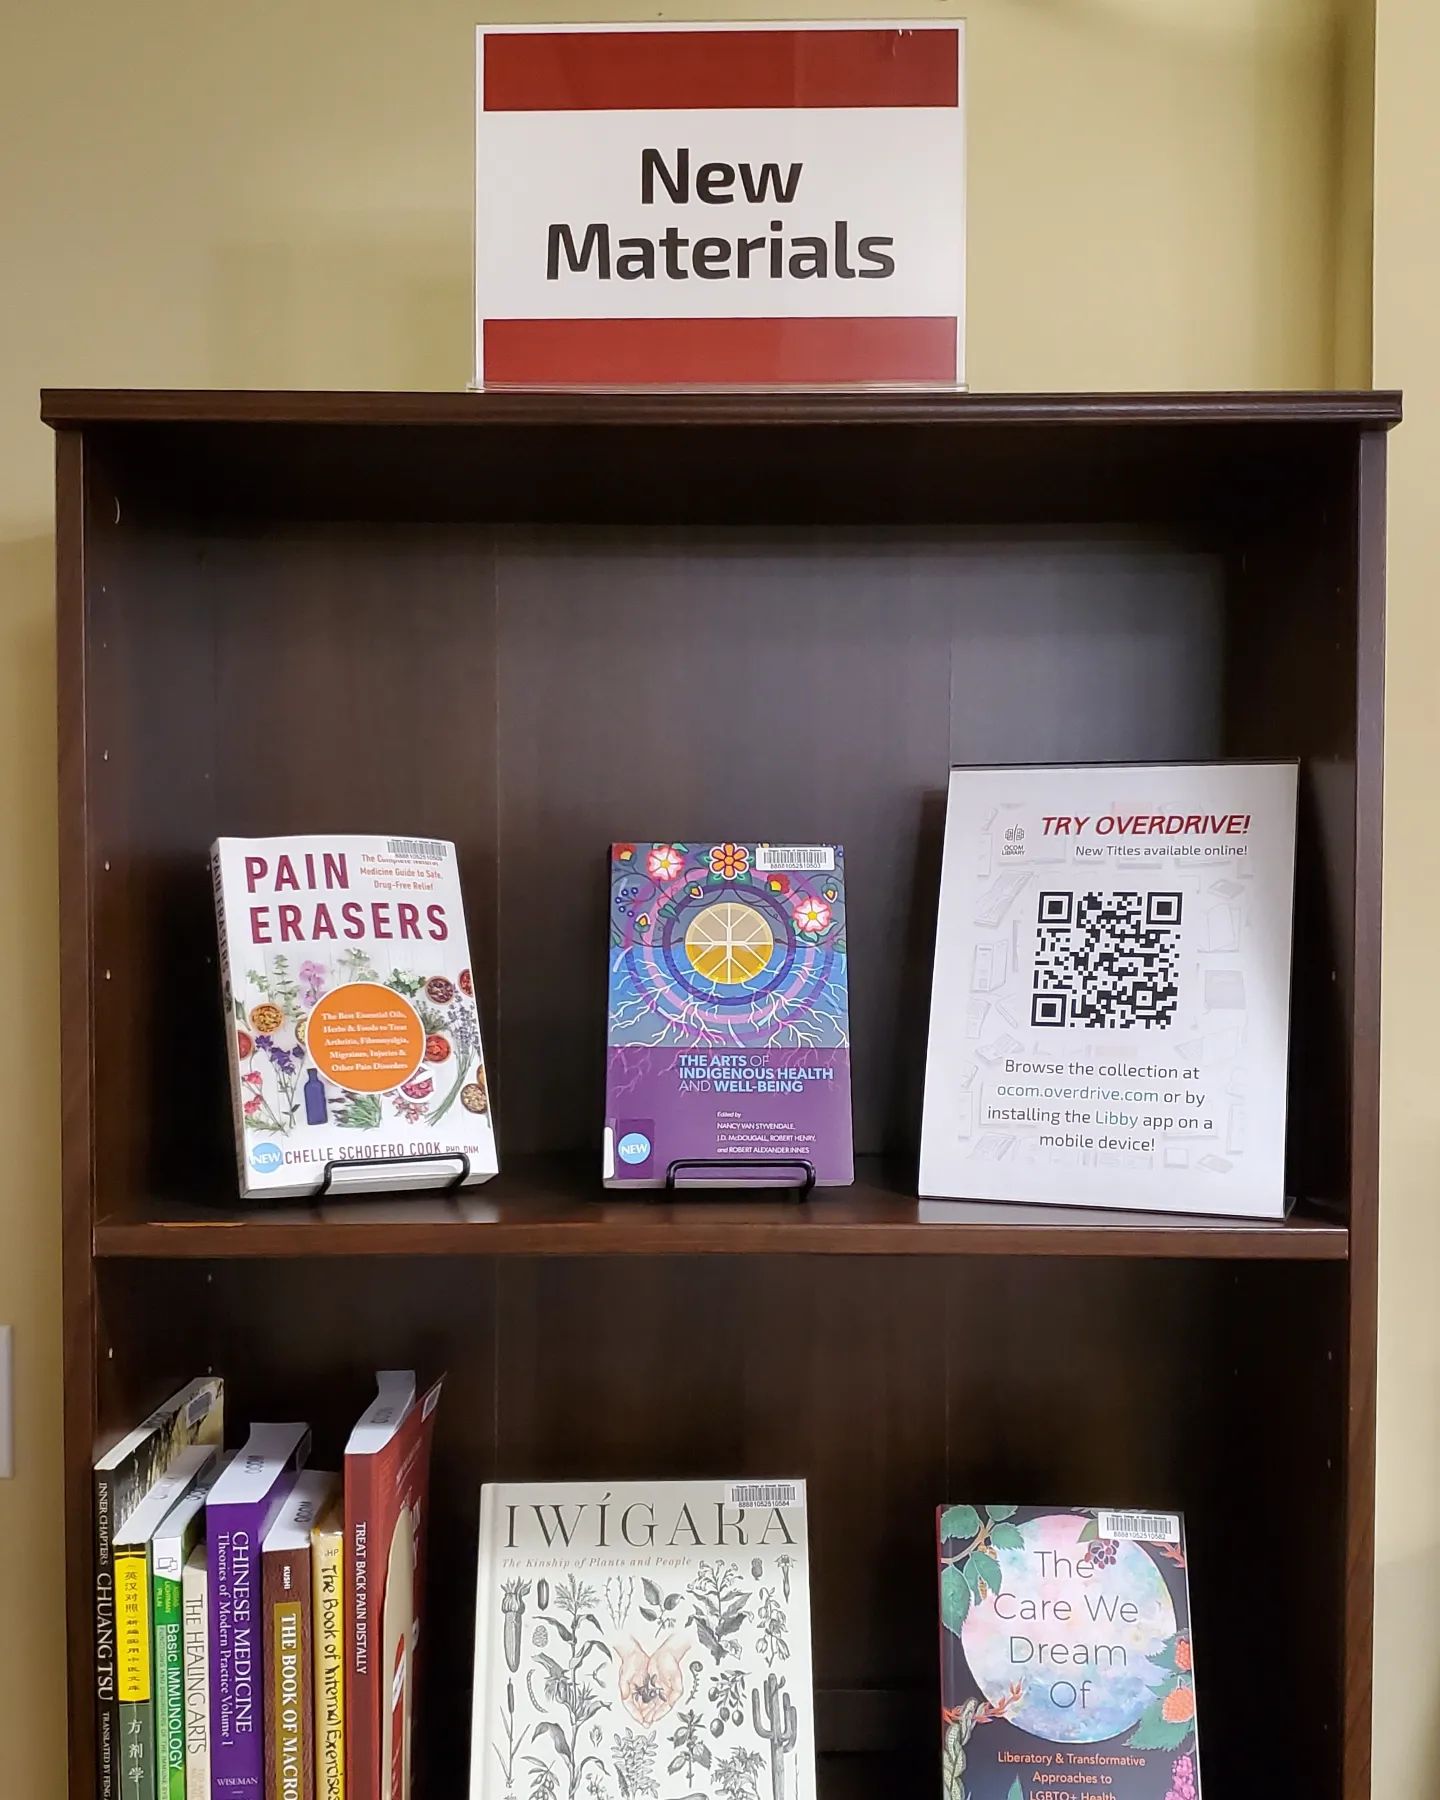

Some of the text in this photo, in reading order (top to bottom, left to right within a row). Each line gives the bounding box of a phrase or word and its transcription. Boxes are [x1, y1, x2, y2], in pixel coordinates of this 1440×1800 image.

[641, 148, 803, 204] New
[546, 220, 896, 281] Materials
[1041, 815, 1252, 835] TRY OVERDRIVE!
[361, 853, 376, 863] The
[1075, 844, 1248, 856] New Titles available online!
[244, 853, 350, 893] PAIN
[360, 867, 393, 876] Medicine
[395, 868, 415, 877] Guide
[374, 880, 434, 890] Drug-Free Relief
[249, 902, 449, 944] ERASERS
[322, 1012, 336, 1020] The
[331, 1064, 354, 1072] Other
[373, 1062, 408, 1070] Disorders
[679, 1055, 770, 1067] THE ARTS OF
[679, 1067, 834, 1080] INDIGENOUS HEALTH
[1005, 1059, 1200, 1079] Browse the collection at
[678, 1080, 804, 1092] AND WELL-BEING
[997, 1084, 1205, 1107] ocom.overdrive.com or by
[987, 1106, 1213, 1130] installing the Libby app on a
[282, 1147, 334, 1164] CHELLE
[339, 1143, 404, 1160] SCHOFFRO
[409, 1142, 441, 1156] COOK
[621, 1143, 648, 1155] NEW
[1039, 1133, 1155, 1151] mobile device!
[251, 1152, 281, 1165] NEW
[99, 1482, 107, 1514] INNER
[99, 1515, 109, 1566] CHAPTERS
[325, 1548, 339, 1557] HP
[218, 1532, 230, 1581] Theories
[502, 1556, 692, 1569] The Kinship of Plants and People
[1033, 1550, 1095, 1579] The
[219, 1584, 231, 1597] of
[283, 1566, 291, 1589] KUSHI
[321, 1564, 339, 1593] The
[185, 1594, 204, 1625] THE
[355, 1521, 367, 1675] TREAT BACK PAIN DISTALLY
[993, 1592, 1138, 1623] Care We
[97, 1573, 113, 1659] CHUANG
[219, 1601, 231, 1647] Modern
[323, 1598, 341, 1640] Book
[167, 1623, 179, 1662] Basic
[232, 1531, 253, 1733] CHINESE MEDICINE
[281, 1613, 296, 1650] THE
[324, 1644, 342, 1661] of
[1010, 1636, 1127, 1667] Dream
[97, 1663, 114, 1701] TSU
[186, 1631, 206, 1706] HEALING
[220, 1650, 232, 1694] Practice
[282, 1654, 297, 1706] BOOK
[325, 1664, 342, 1726] Internal
[1050, 1680, 1092, 1709] Of
[167, 1667, 183, 1770] IMMUNOLOGY
[221, 1695, 233, 1738] Volume
[282, 1709, 298, 1733] OF
[102, 1711, 111, 1763] TRANSLATED
[160, 1729, 166, 1738] OF
[187, 1709, 207, 1754] ARTS
[127, 1719, 145, 1783] 方剂学
[998, 1752, 1146, 1766] Liberatory & Transformative
[103, 1764, 111, 1774] BY
[216, 1777, 258, 1786] WISEMAN
[1032, 1771, 1112, 1785] Approaches to
